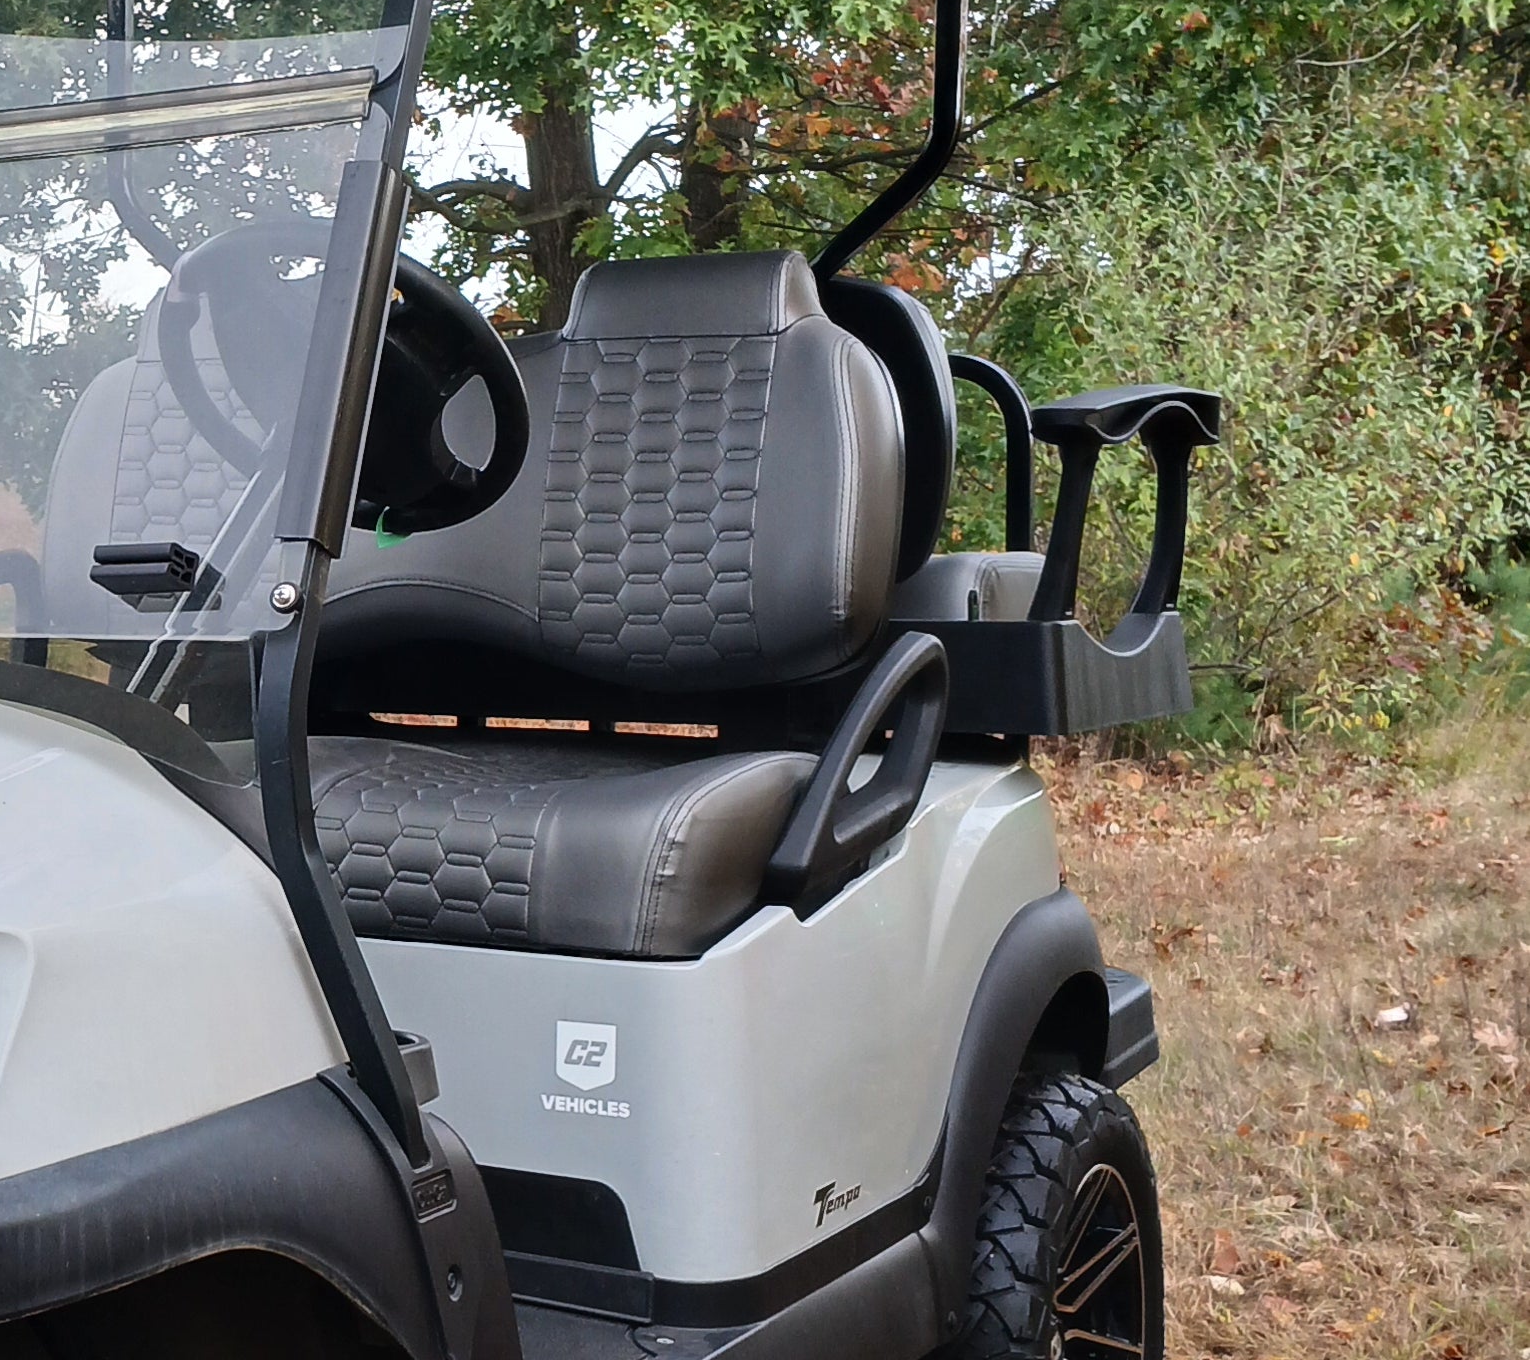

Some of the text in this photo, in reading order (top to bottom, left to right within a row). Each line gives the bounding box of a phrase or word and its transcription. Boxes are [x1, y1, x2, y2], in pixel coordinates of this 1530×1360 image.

[563, 1039, 608, 1067] C2
[540, 1094, 631, 1119] VEHICLES
[813, 1180, 862, 1228] Tempo
